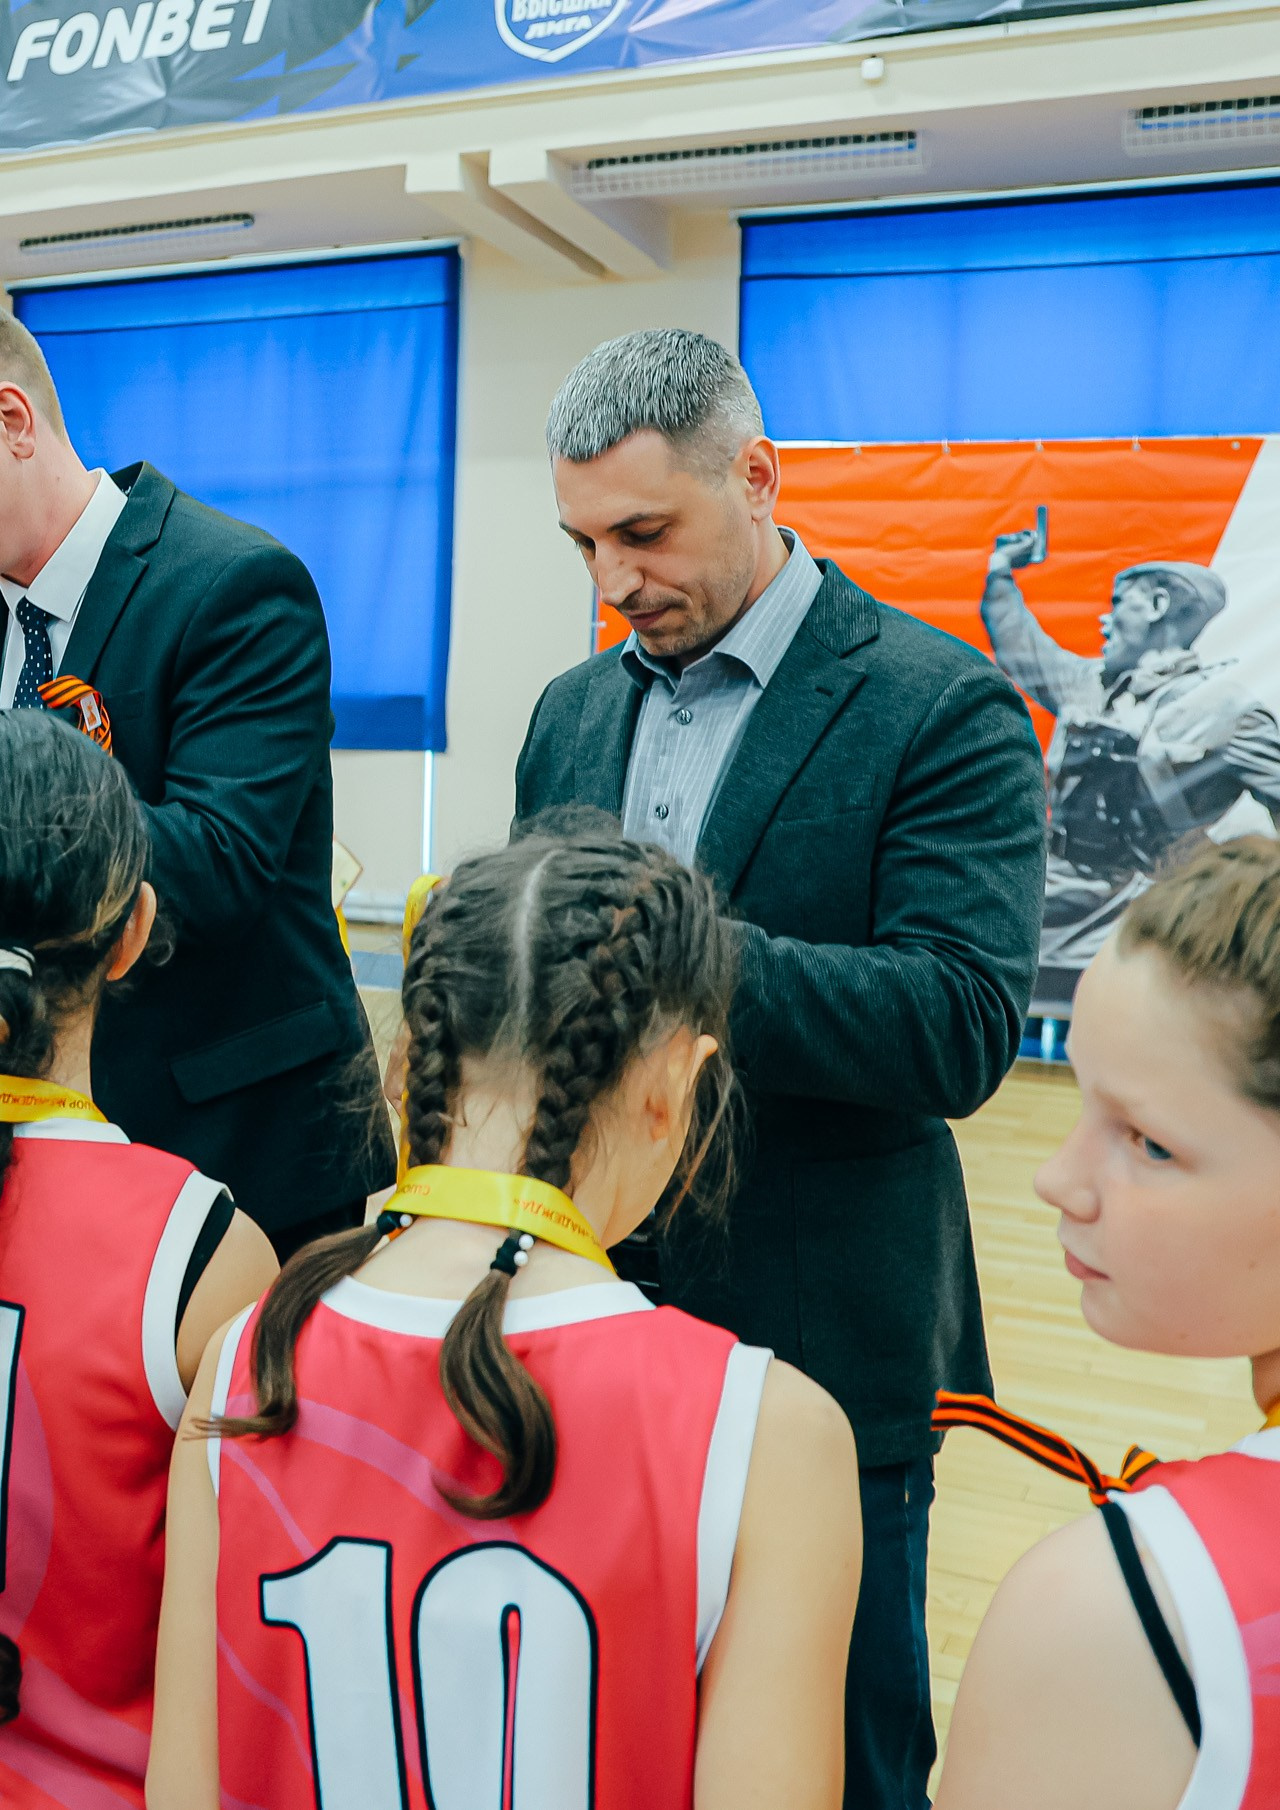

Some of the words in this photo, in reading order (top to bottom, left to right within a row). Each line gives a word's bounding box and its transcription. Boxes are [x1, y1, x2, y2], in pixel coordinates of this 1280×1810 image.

[6, 0, 273, 82] FONBET
[524, 14, 593, 40] ЛИГА
[259, 1536, 600, 1810] 10
